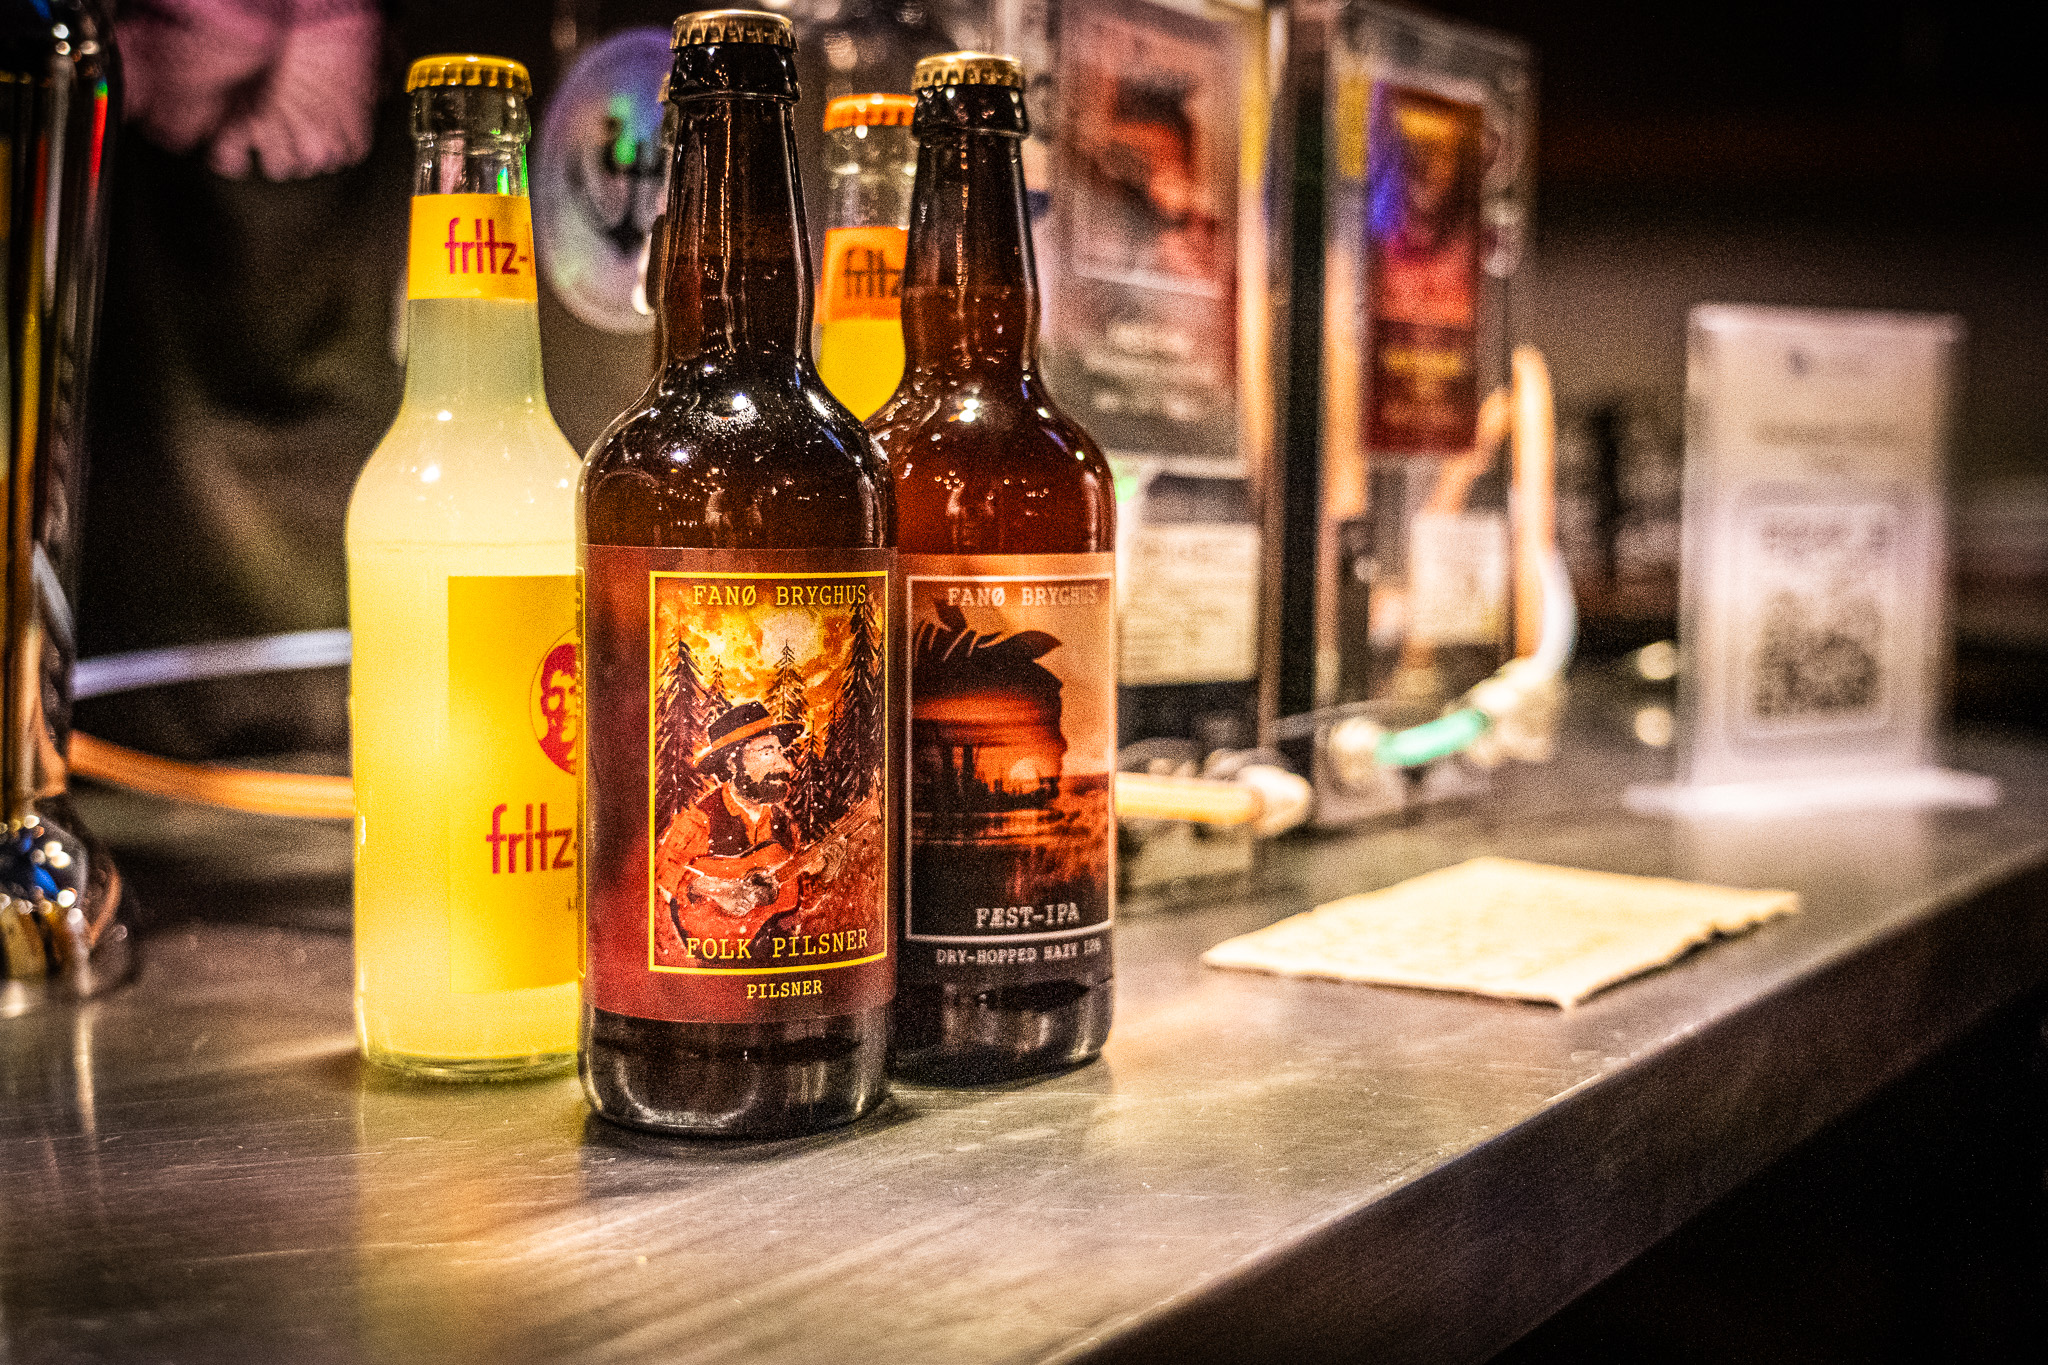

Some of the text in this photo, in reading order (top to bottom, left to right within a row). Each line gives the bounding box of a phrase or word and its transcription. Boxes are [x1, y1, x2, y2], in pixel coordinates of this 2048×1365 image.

[692, 584, 866, 606] FANØ BRYGHUS
[948, 586, 1005, 607] FANØ
[685, 928, 868, 960] FOLK PILSNER
[936, 946, 1038, 965] DRY-HOPPED
[746, 979, 823, 1000] PILSNER
